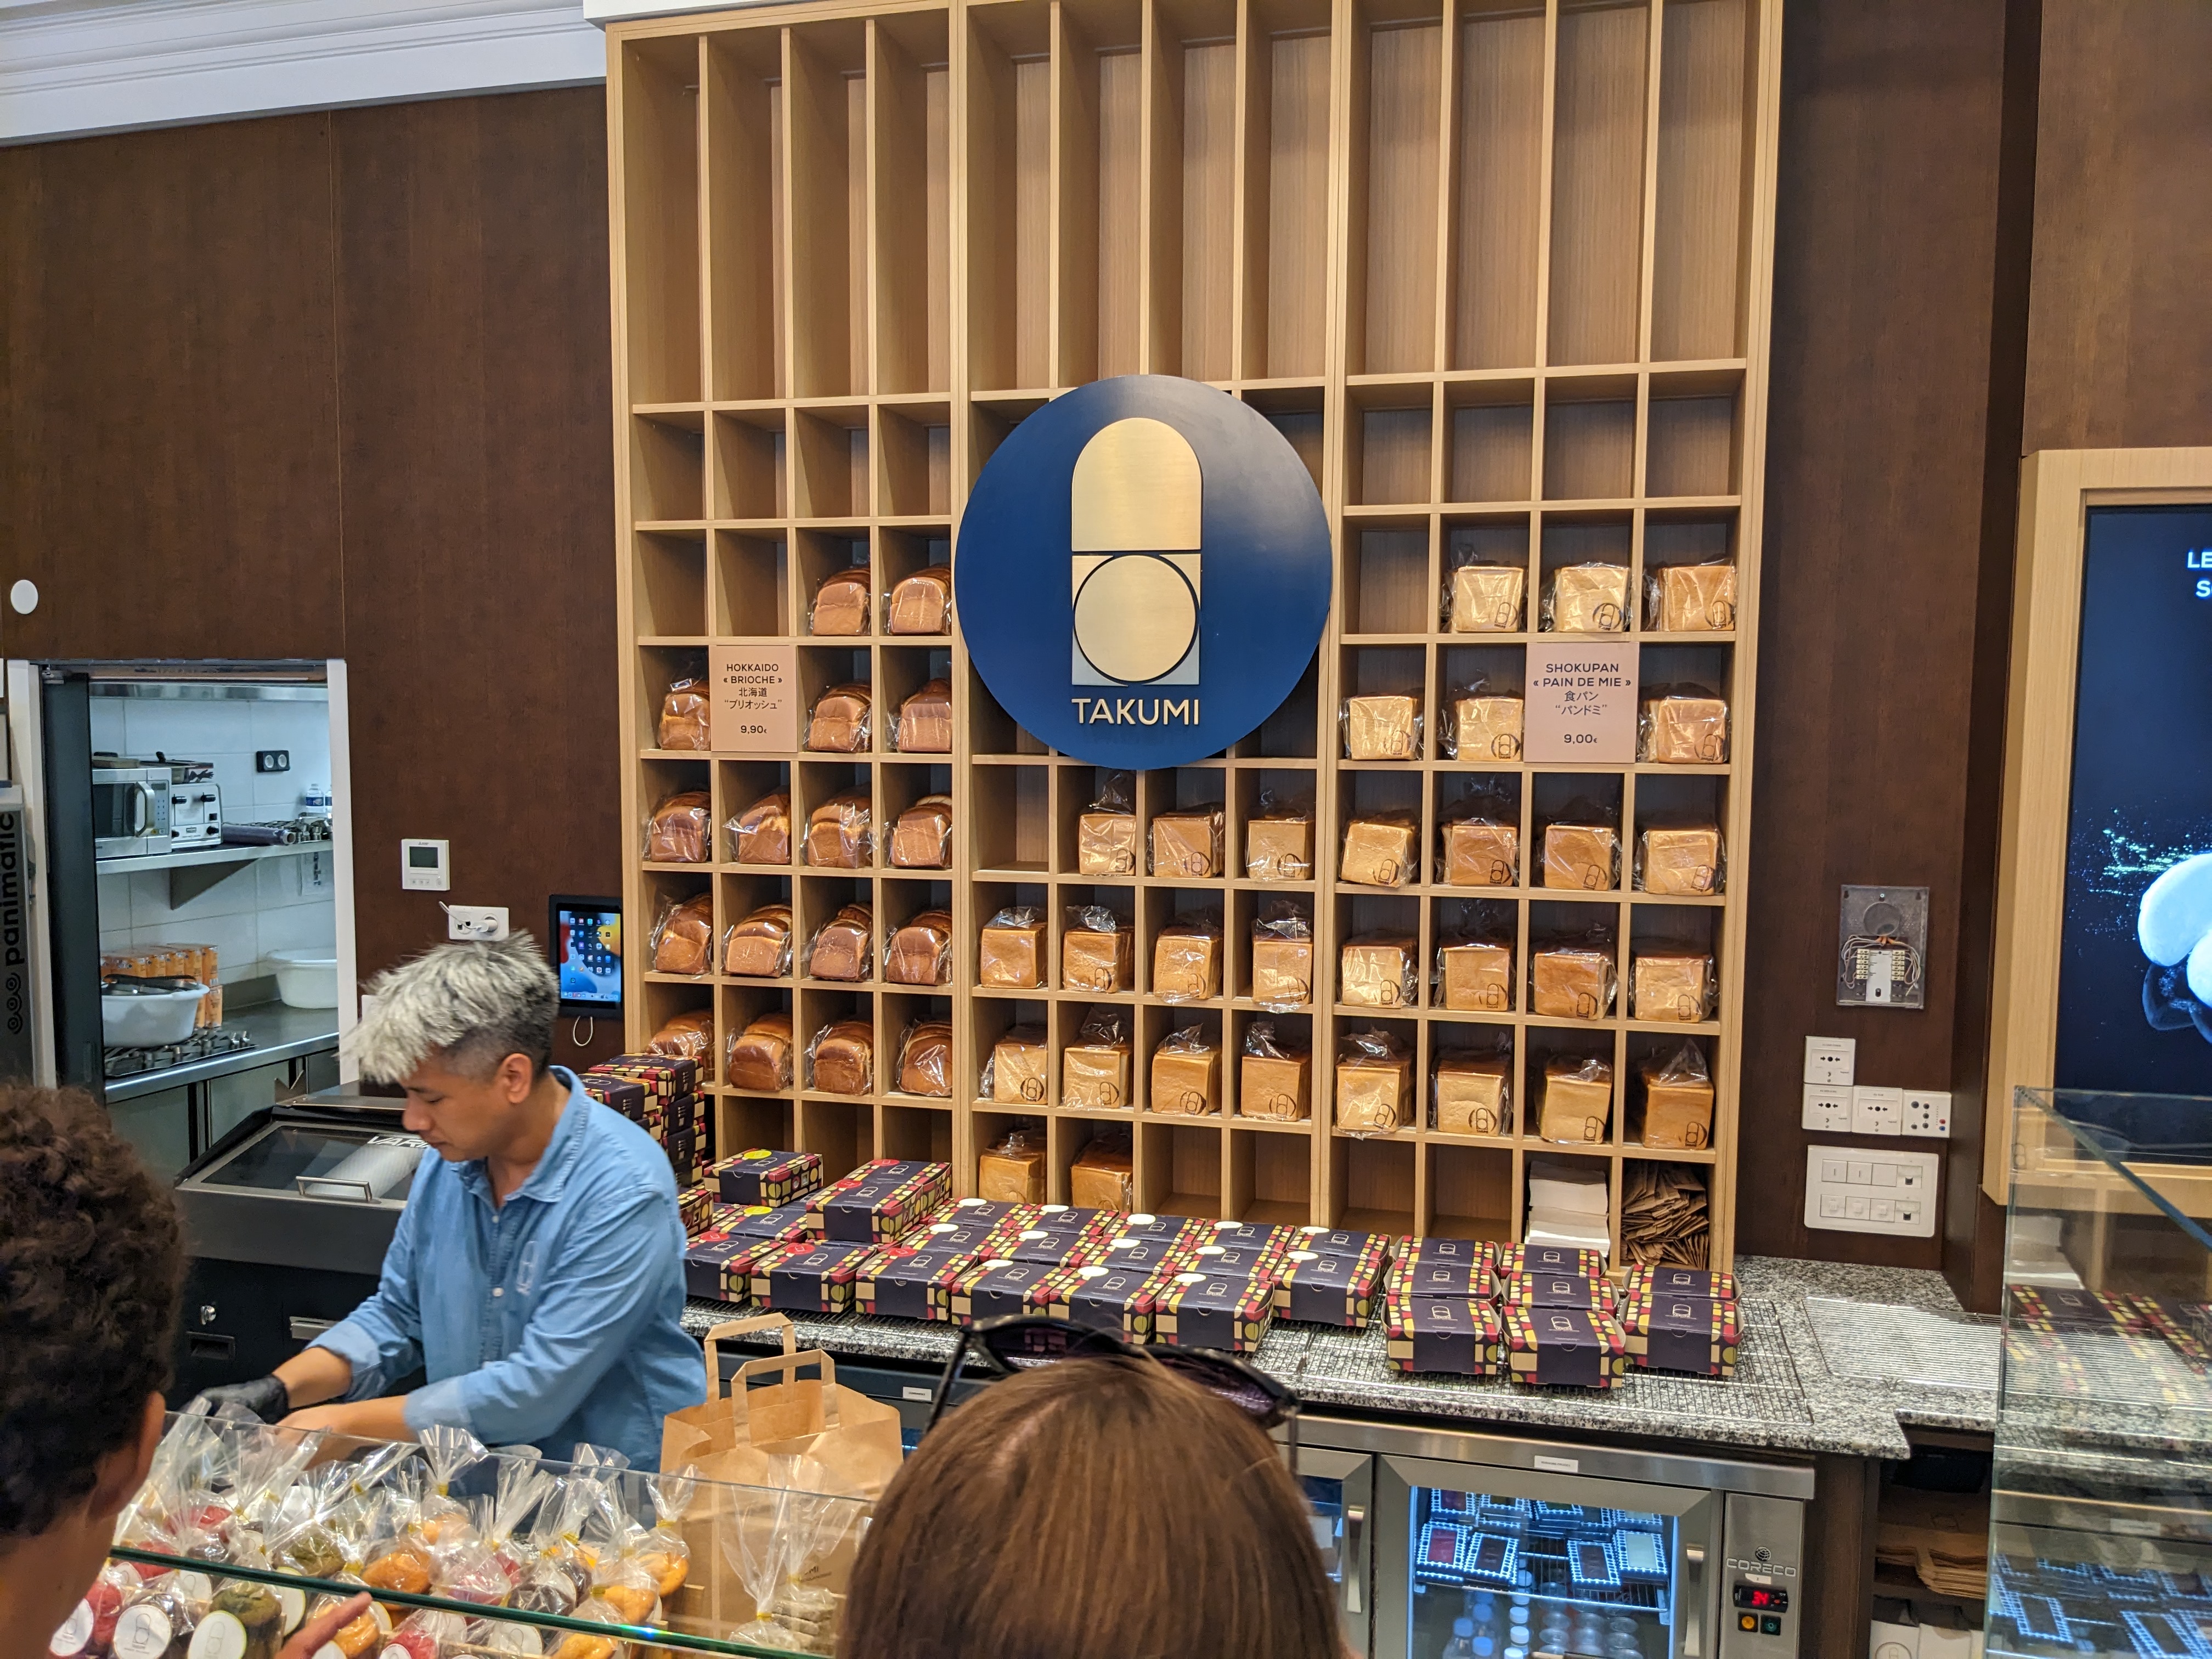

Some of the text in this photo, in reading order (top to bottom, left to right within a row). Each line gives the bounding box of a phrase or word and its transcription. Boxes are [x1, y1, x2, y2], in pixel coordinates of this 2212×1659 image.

[2196, 580, 2212, 597] S
[726, 663, 779, 672] HOKKAIDO
[1545, 663, 1619, 673] SHOKUPAN
[731, 675, 775, 684] BRIOCHE
[1543, 678, 1573, 687] PAIN
[1577, 678, 1594, 687] DE
[1598, 677, 1622, 687] MIE
[738, 687, 768, 697] 北海道
[1564, 690, 1599, 702] 食パン
[1071, 698, 1199, 725] TAKUMI
[1726, 1558, 1796, 1577] CORECO
